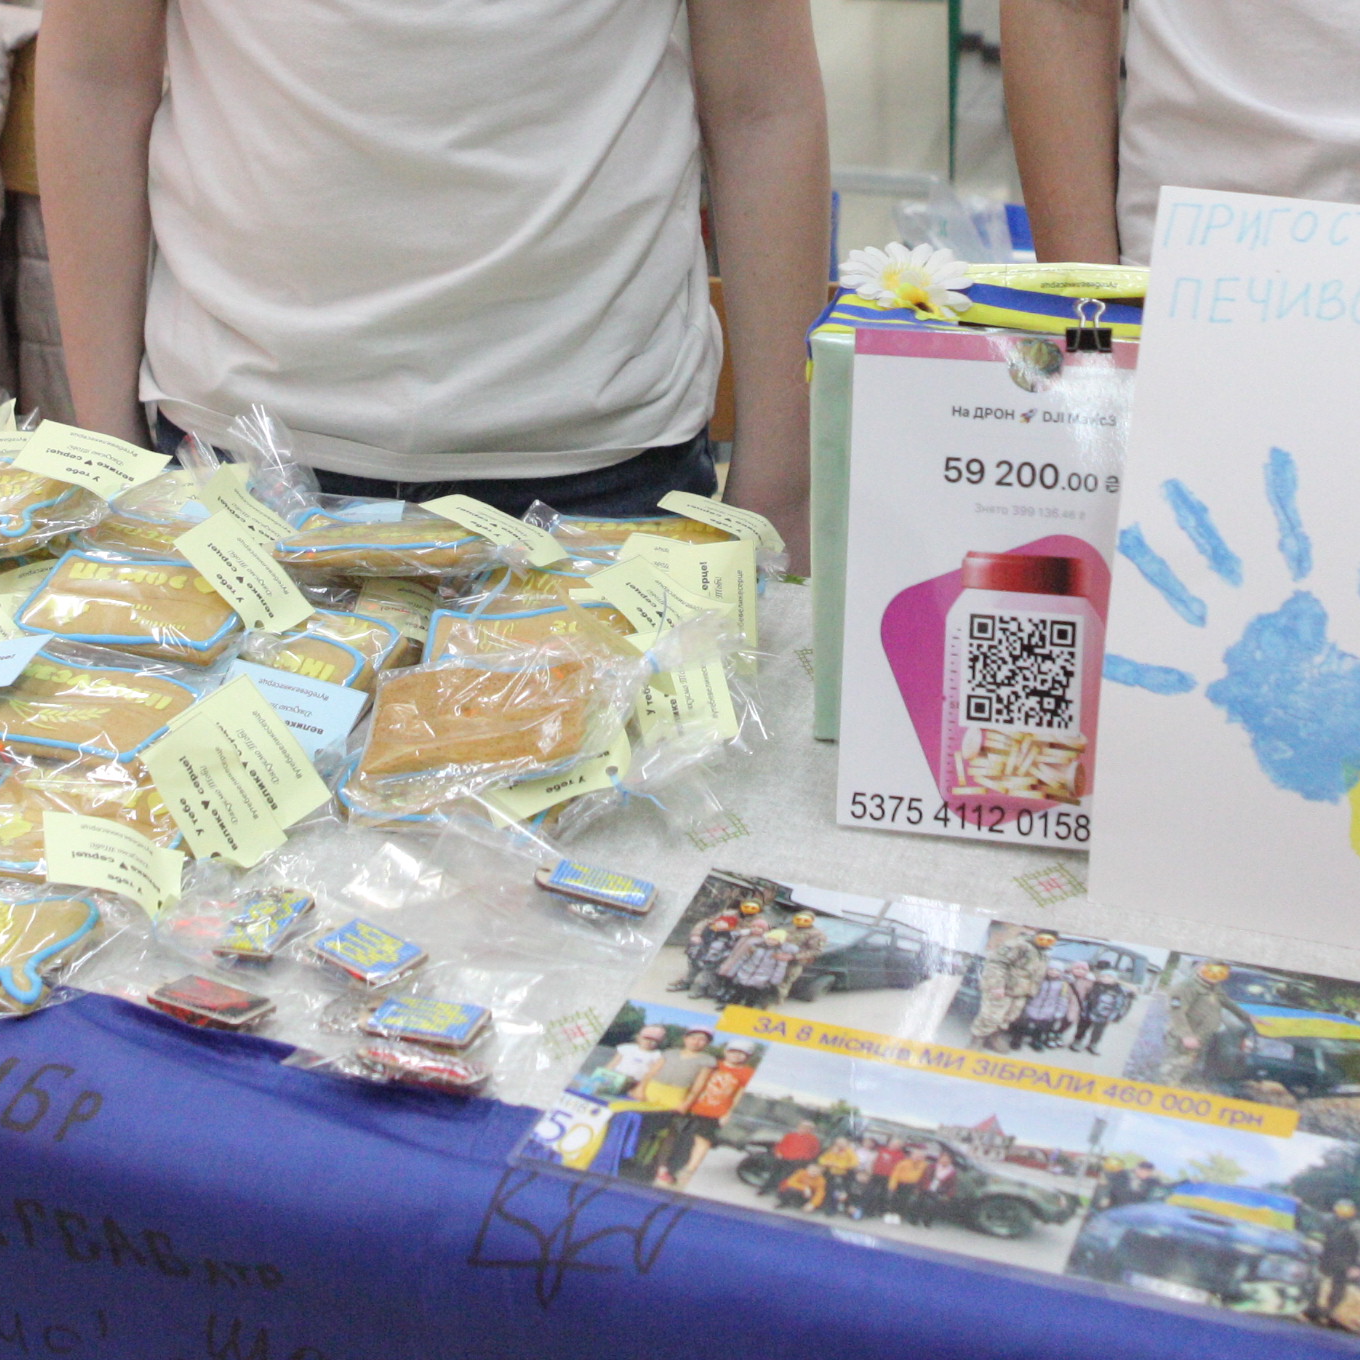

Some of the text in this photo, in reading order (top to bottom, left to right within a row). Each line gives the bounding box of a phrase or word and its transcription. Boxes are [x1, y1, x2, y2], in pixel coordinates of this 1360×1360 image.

[952, 405, 970, 418] На
[973, 406, 1016, 421] ДРОН
[1042, 411, 1065, 424] DJI
[45, 447, 135, 482] велике серце!
[65, 467, 90, 478] тебе
[944, 456, 985, 485] 59
[995, 459, 1099, 493] 200.00
[207, 542, 274, 619] велике серце!
[216, 573, 237, 596] тебе
[624, 581, 658, 609] серце!
[178, 755, 239, 851] велике серце!
[249, 769, 279, 812] велике
[545, 779, 575, 794] тебе
[179, 797, 199, 827] тебе
[850, 791, 1091, 842] 5375 4112 0158
[71, 850, 115, 864] серце!
[752, 1016, 1265, 1129] ЗА 8 місяців МИ ЗІБРАЛИ 460 000 грн
[535, 1110, 594, 1154] 50
